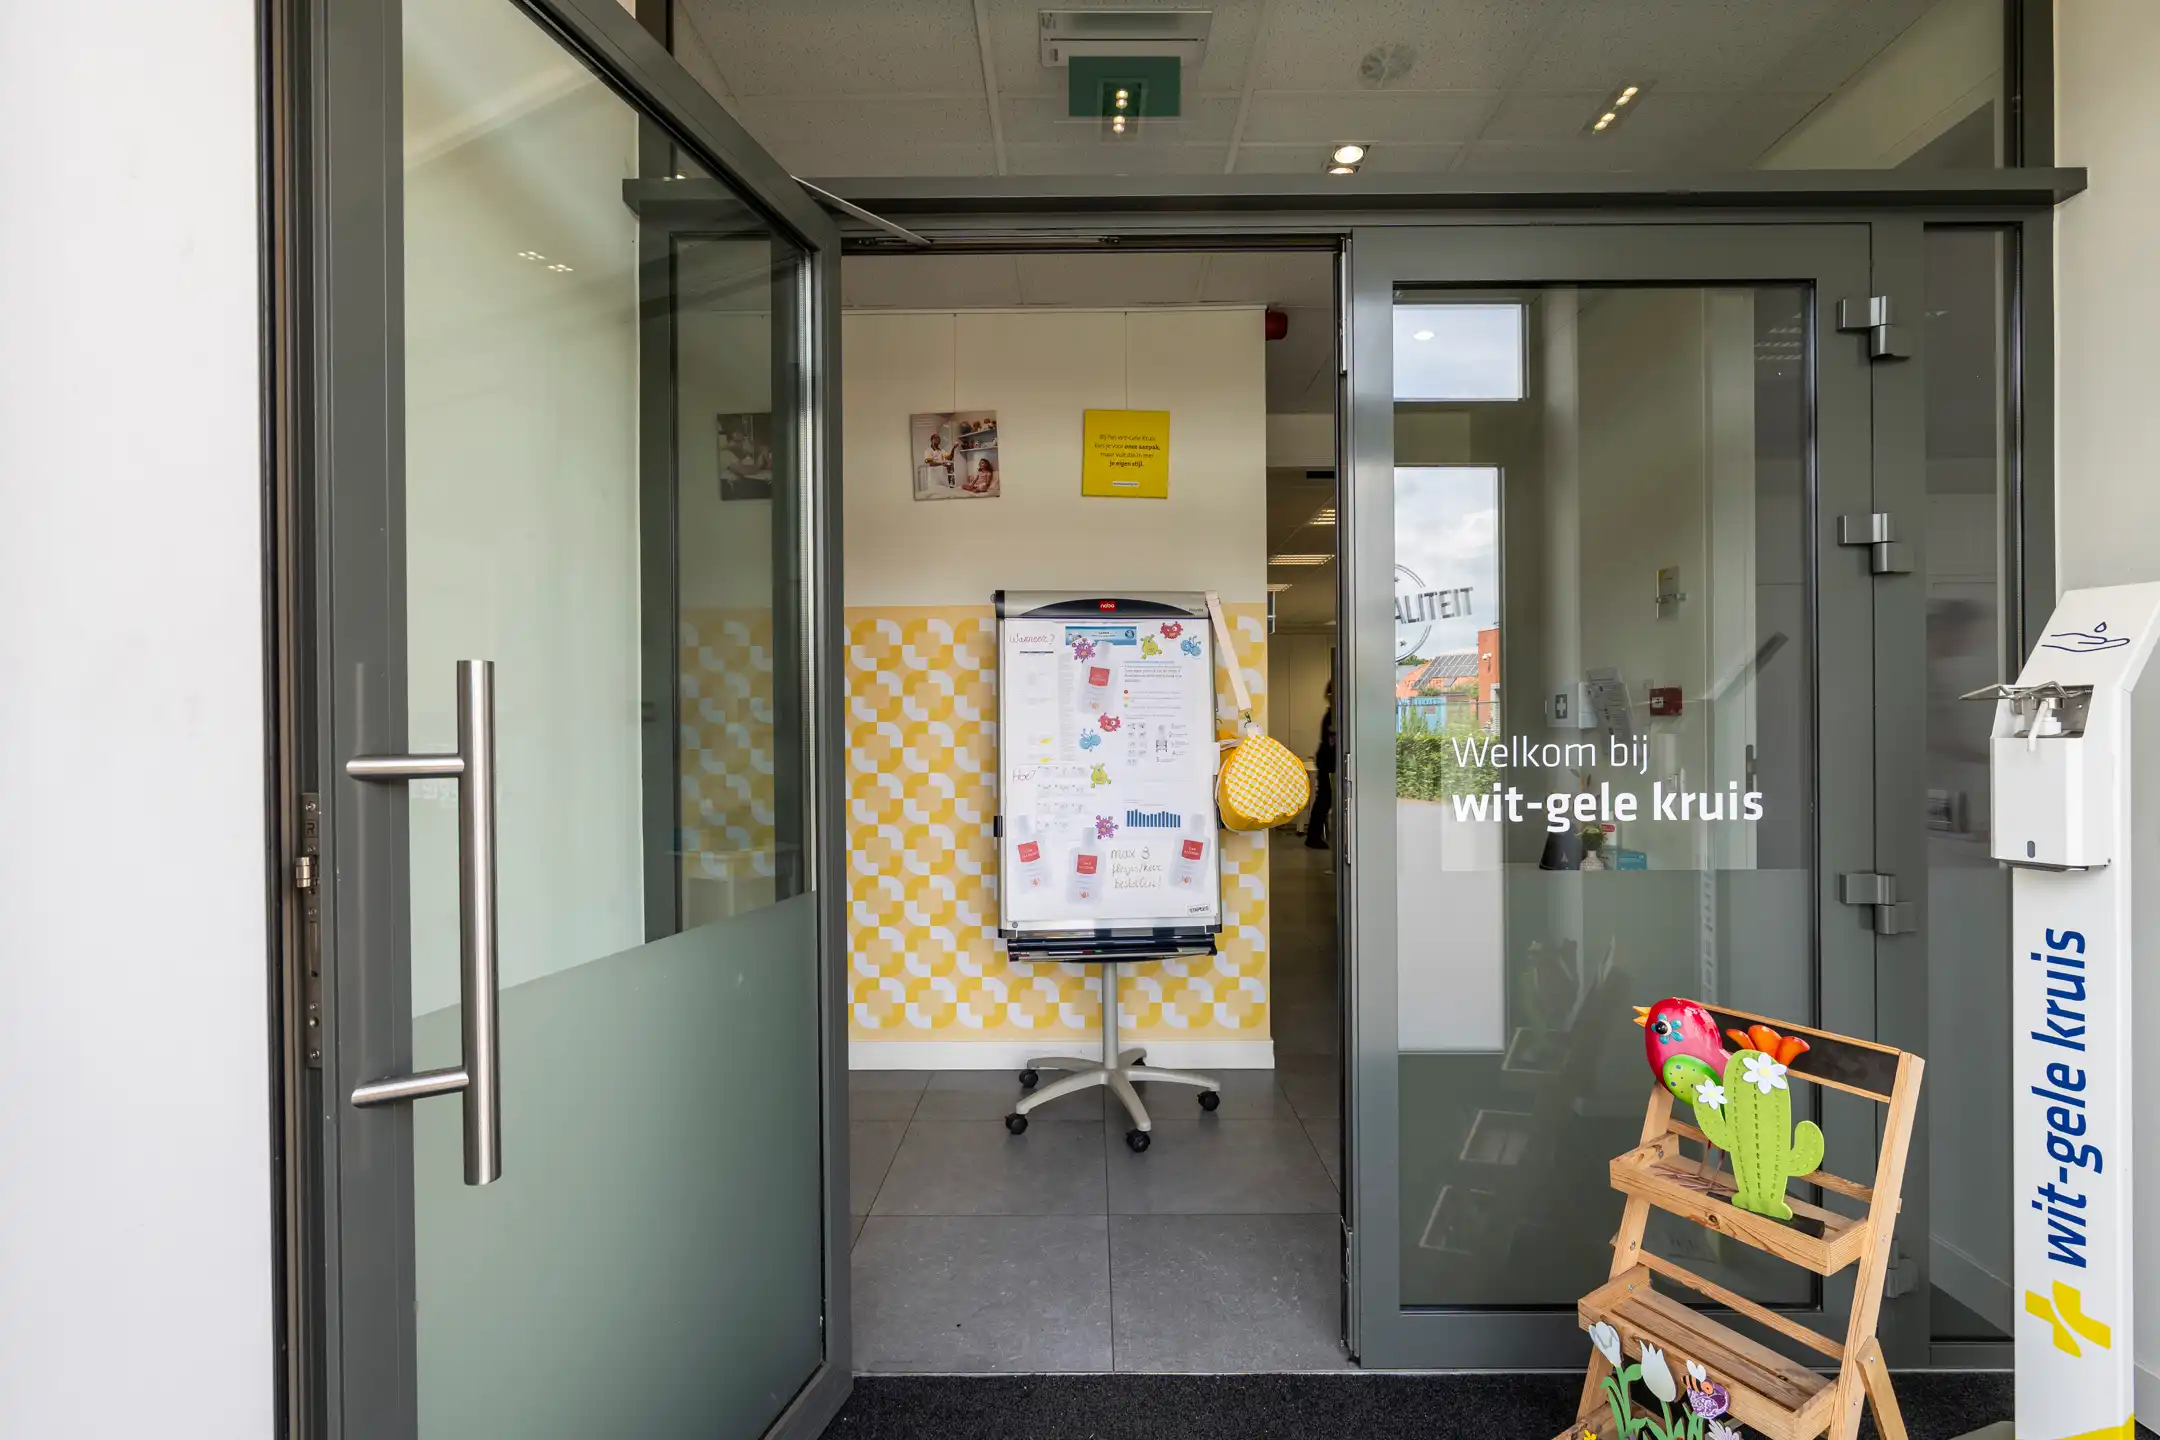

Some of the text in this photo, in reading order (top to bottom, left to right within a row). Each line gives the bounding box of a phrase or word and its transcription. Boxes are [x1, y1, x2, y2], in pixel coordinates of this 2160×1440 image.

[1452, 734, 1648, 775] Welkom bij
[1452, 781, 1763, 833] wit-gele kruis
[1110, 845, 1151, 860] max 3
[1189, 905, 1210, 913] STAPLES
[2031, 928, 2103, 1269] wit-gele kruis
